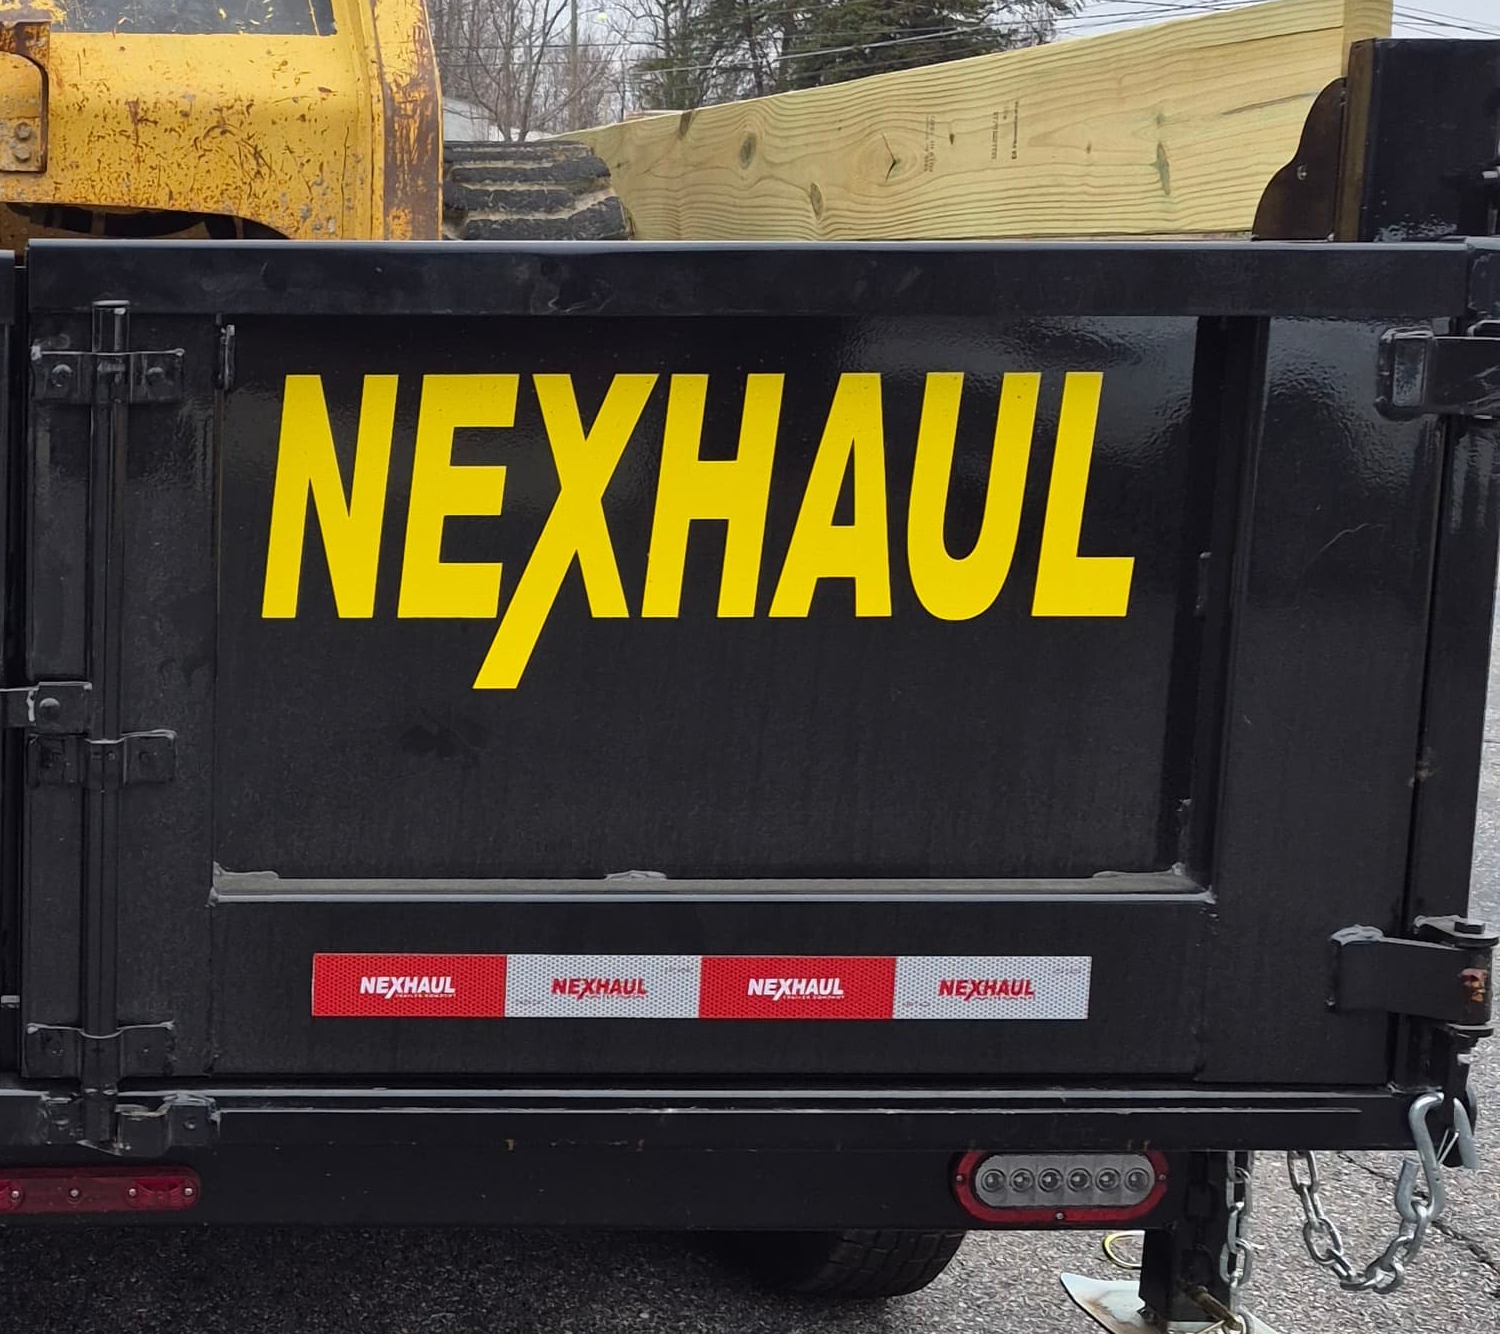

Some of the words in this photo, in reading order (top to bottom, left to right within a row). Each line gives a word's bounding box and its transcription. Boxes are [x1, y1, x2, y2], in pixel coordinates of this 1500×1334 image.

[261, 371, 1135, 689] NEXHAUL
[360, 976, 456, 999] NEXHAUL
[551, 977, 647, 1000] NEXHAUL
[747, 978, 844, 1001] NEXHAUL
[938, 978, 1036, 1002] NEXHAUL
